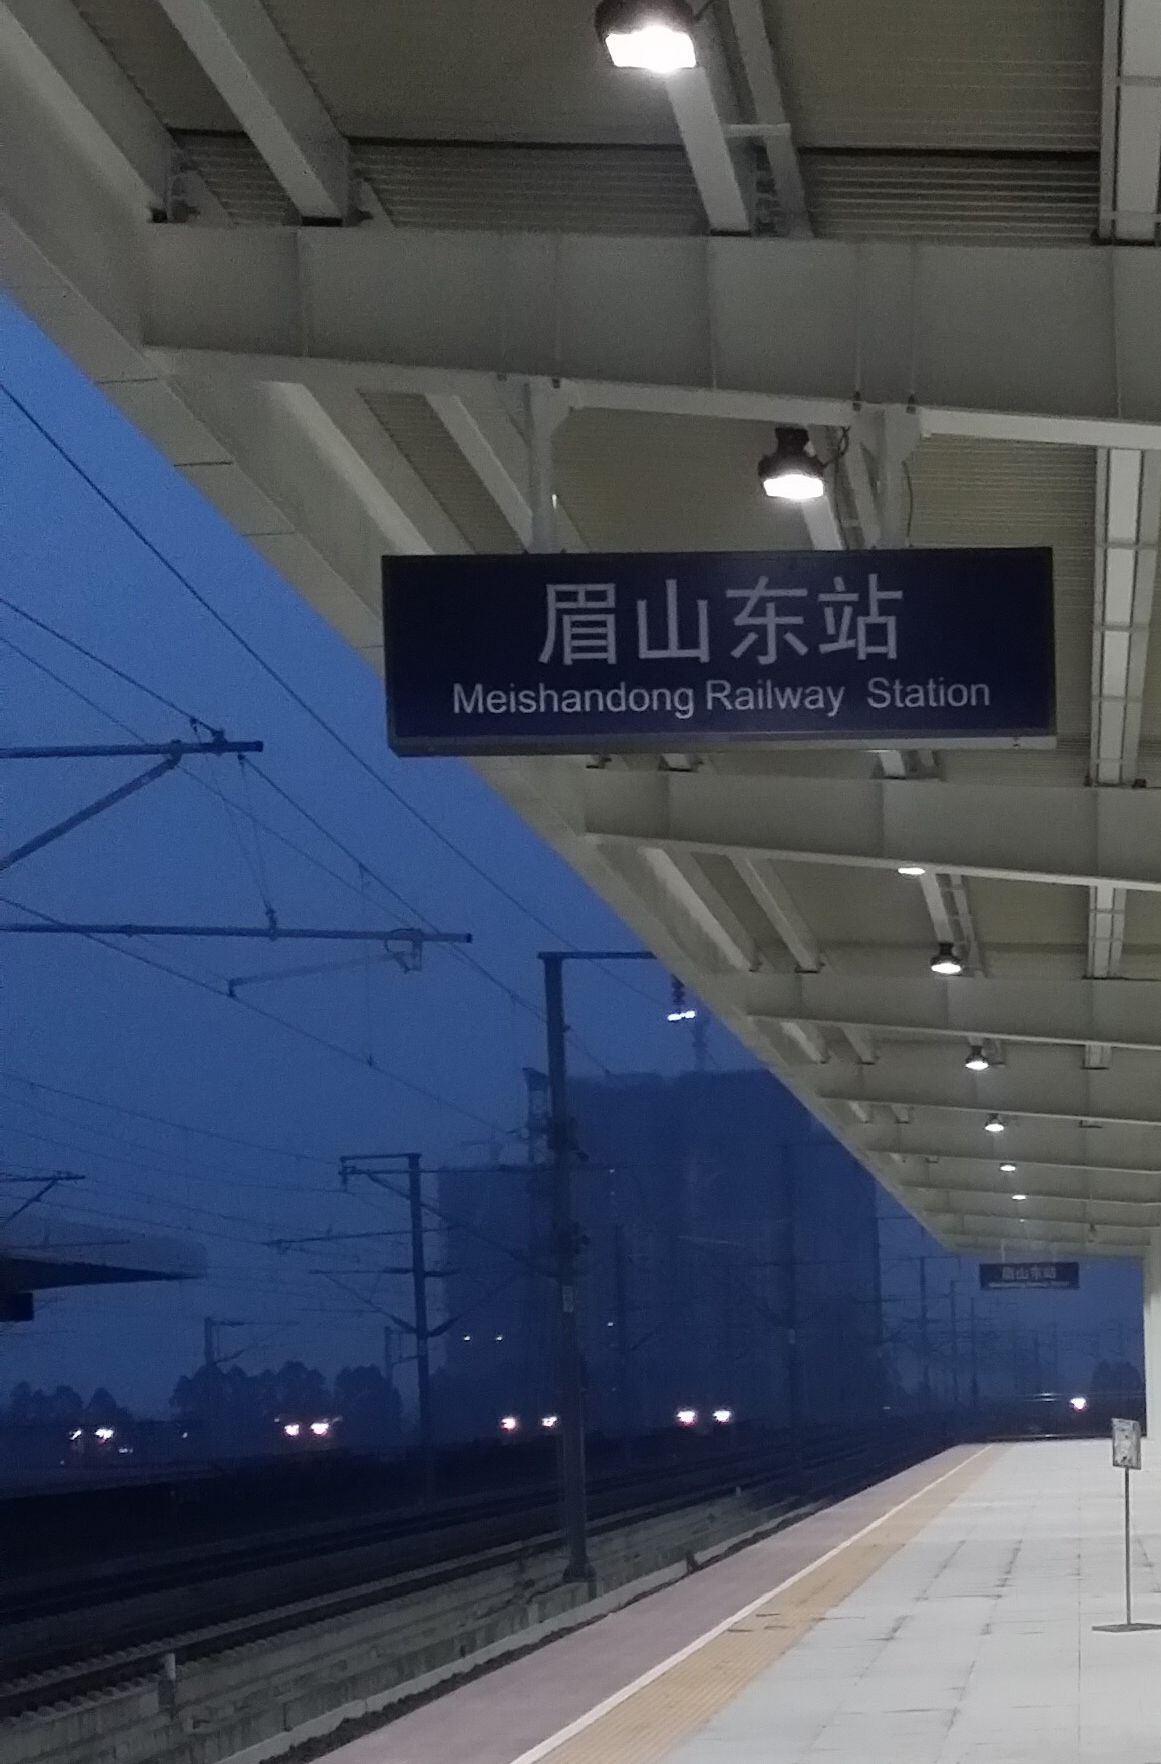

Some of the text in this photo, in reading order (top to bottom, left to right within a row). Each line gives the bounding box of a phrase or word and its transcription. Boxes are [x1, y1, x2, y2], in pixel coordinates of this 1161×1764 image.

[538, 573, 903, 665] 眉山东站
[453, 676, 991, 720] Meishandong Railway Station
